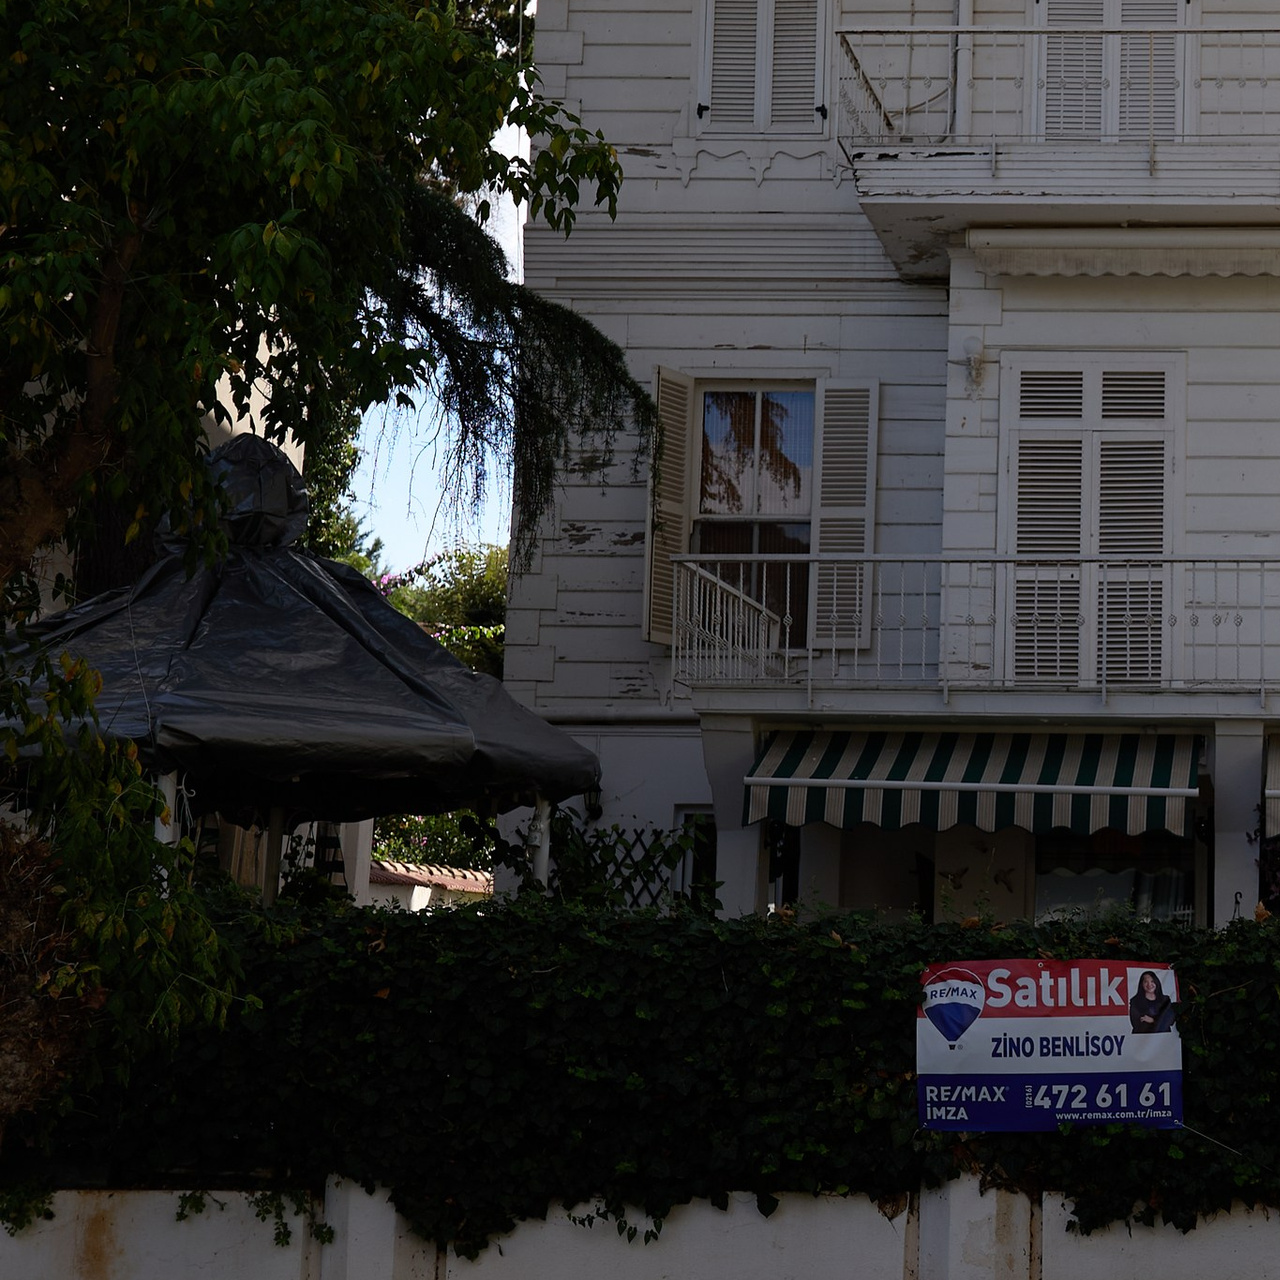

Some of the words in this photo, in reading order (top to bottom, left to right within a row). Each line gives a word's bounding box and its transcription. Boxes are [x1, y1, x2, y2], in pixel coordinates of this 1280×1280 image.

[930, 986, 978, 1000] RE/MAX
[986, 967, 1125, 1007] Satılık
[991, 1032, 1034, 1058] ZİNO
[1039, 1031, 1125, 1057] BENLİSOY
[925, 1085, 1006, 1102] RE/MAX
[1034, 1084, 1088, 1109] 472
[1095, 1083, 1128, 1108] 61
[1139, 1081, 1171, 1107] 61
[926, 1103, 969, 1120] İMZA
[1055, 1109, 1172, 1121] www.remax.com.tr/imza
